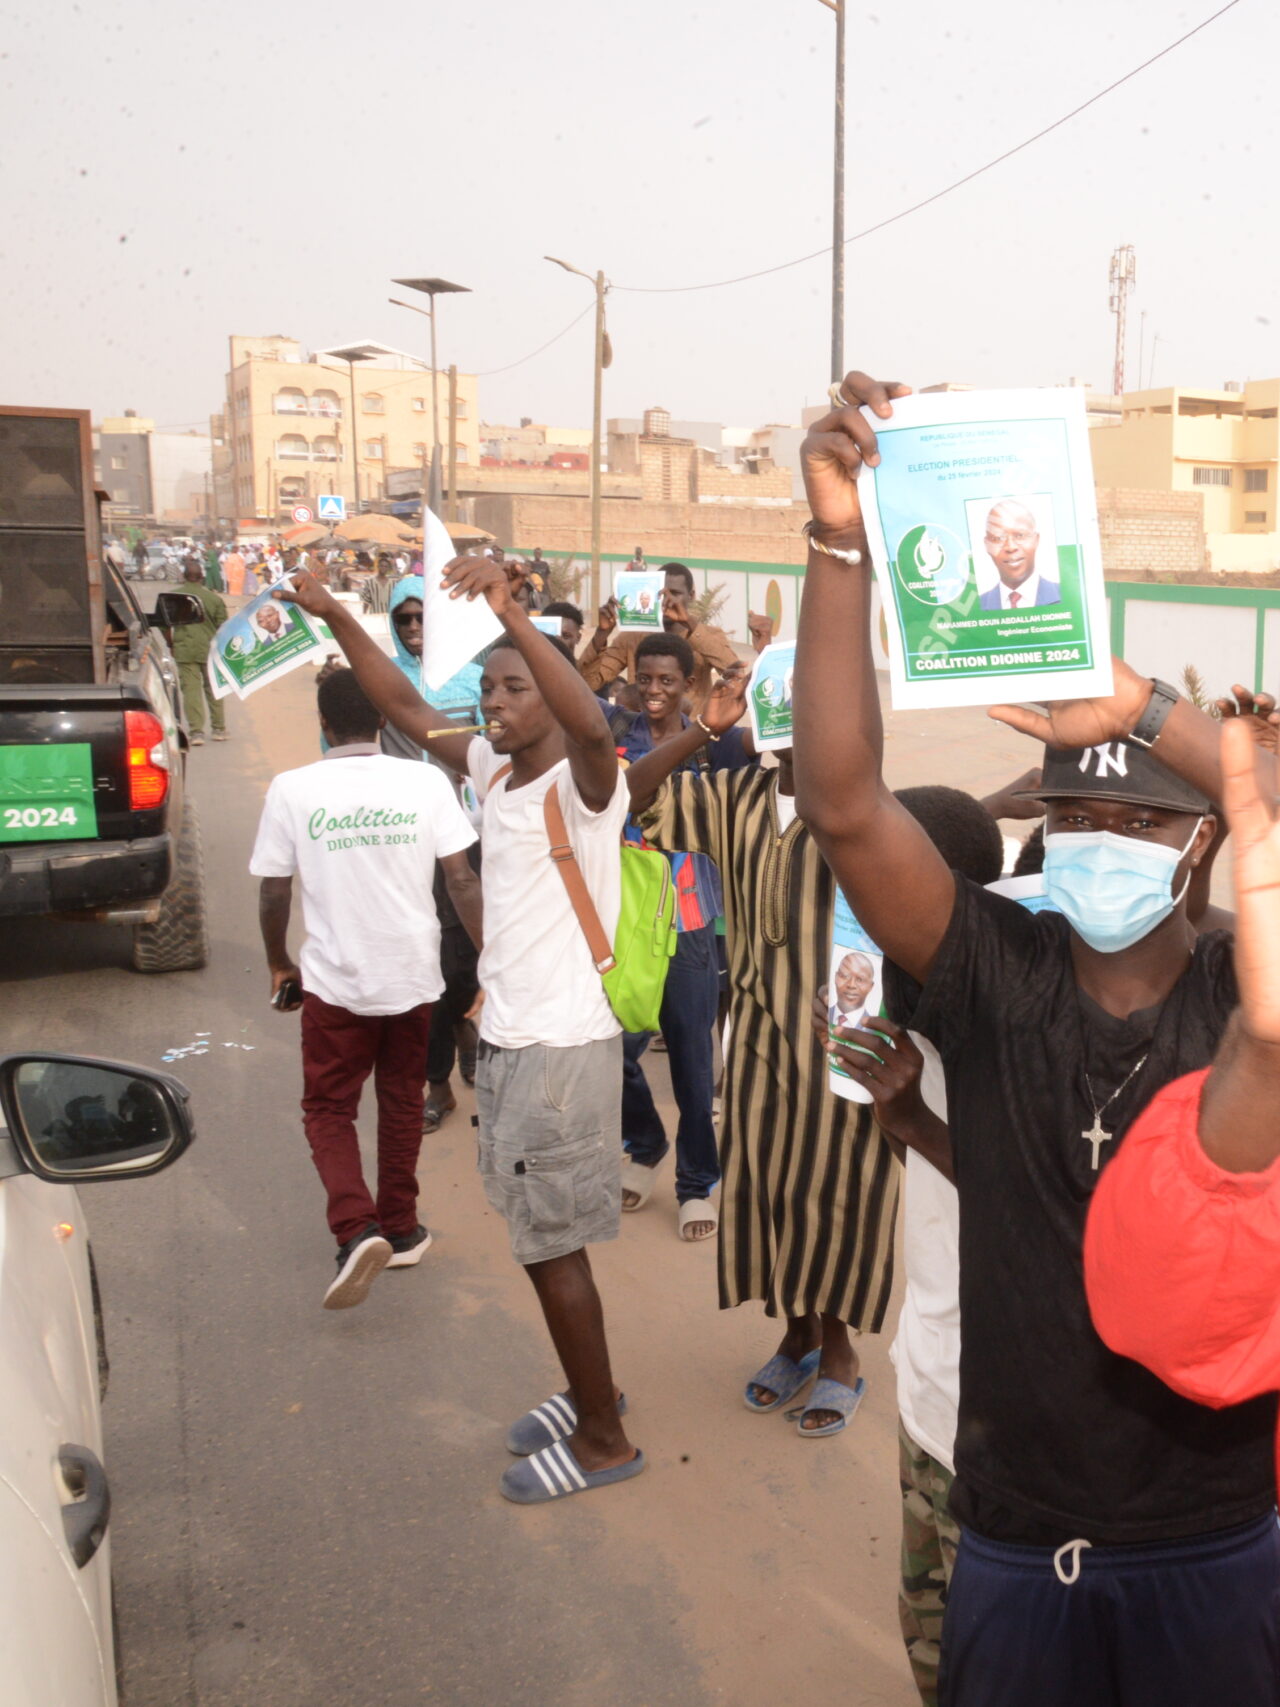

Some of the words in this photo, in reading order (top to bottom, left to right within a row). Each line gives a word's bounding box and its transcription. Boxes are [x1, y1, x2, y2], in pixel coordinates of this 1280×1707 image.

[907, 460, 950, 473] ELECTION
[1042, 612, 1072, 621] DIONNE
[916, 655, 987, 671] COALITION
[991, 652, 1043, 666] DIONNE
[1046, 648, 1080, 661] 2024
[1078, 741, 1129, 778] NY
[4, 807, 78, 828] 2024
[308, 806, 417, 841] Coalition
[326, 835, 381, 851] DIONNE
[384, 833, 418, 845] 2024
